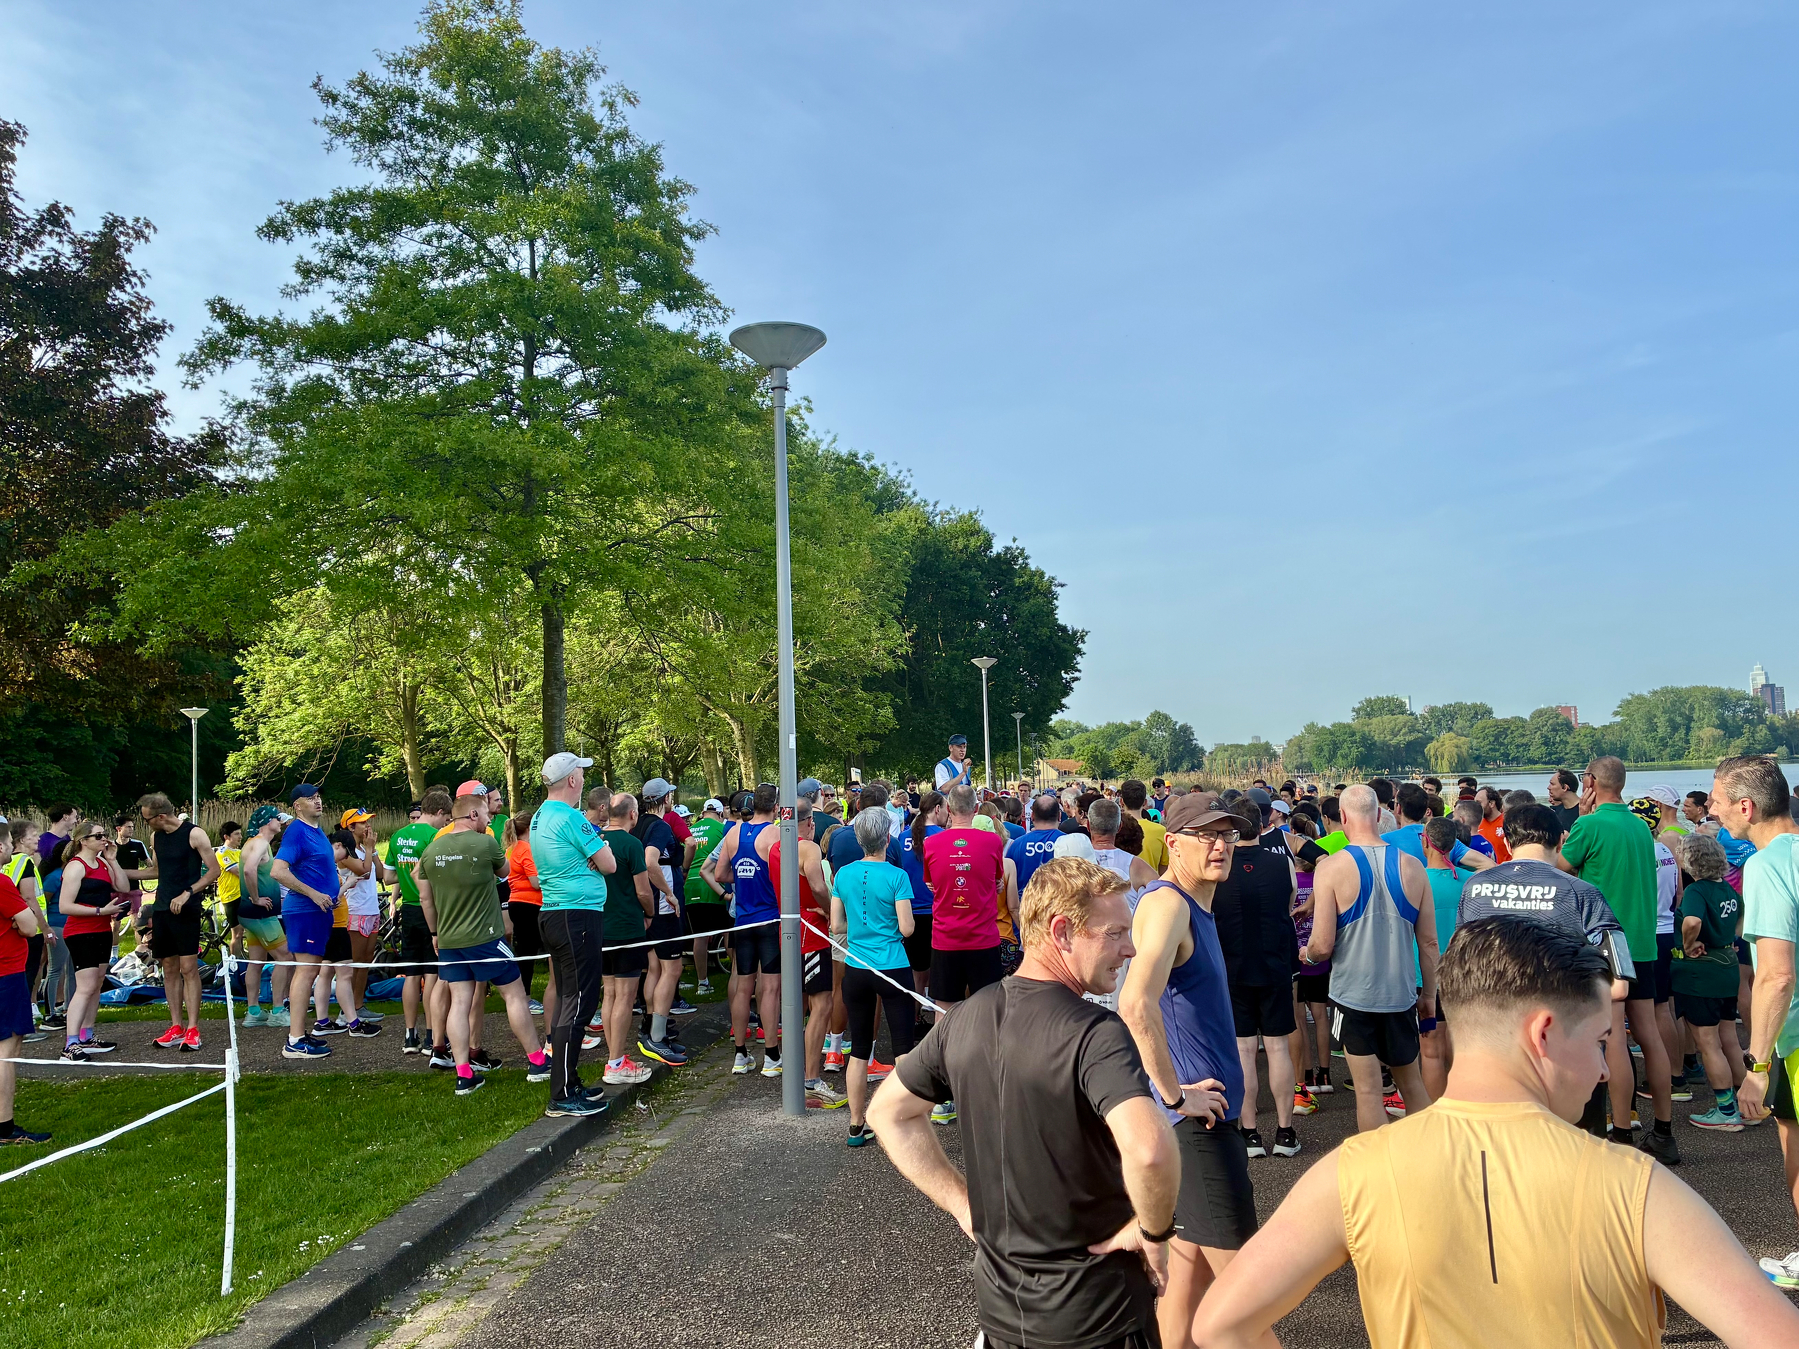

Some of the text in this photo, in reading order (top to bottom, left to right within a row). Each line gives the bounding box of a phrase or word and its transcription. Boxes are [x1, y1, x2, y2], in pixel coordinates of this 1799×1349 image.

[396, 837, 419, 847] Sterker
[1025, 840, 1055, 857] 500
[1471, 883, 1557, 899] PRIJSVRIJ
[1492, 898, 1554, 910] vakanties
[1719, 899, 1738, 918] 250
[861, 910, 869, 926] RUN
